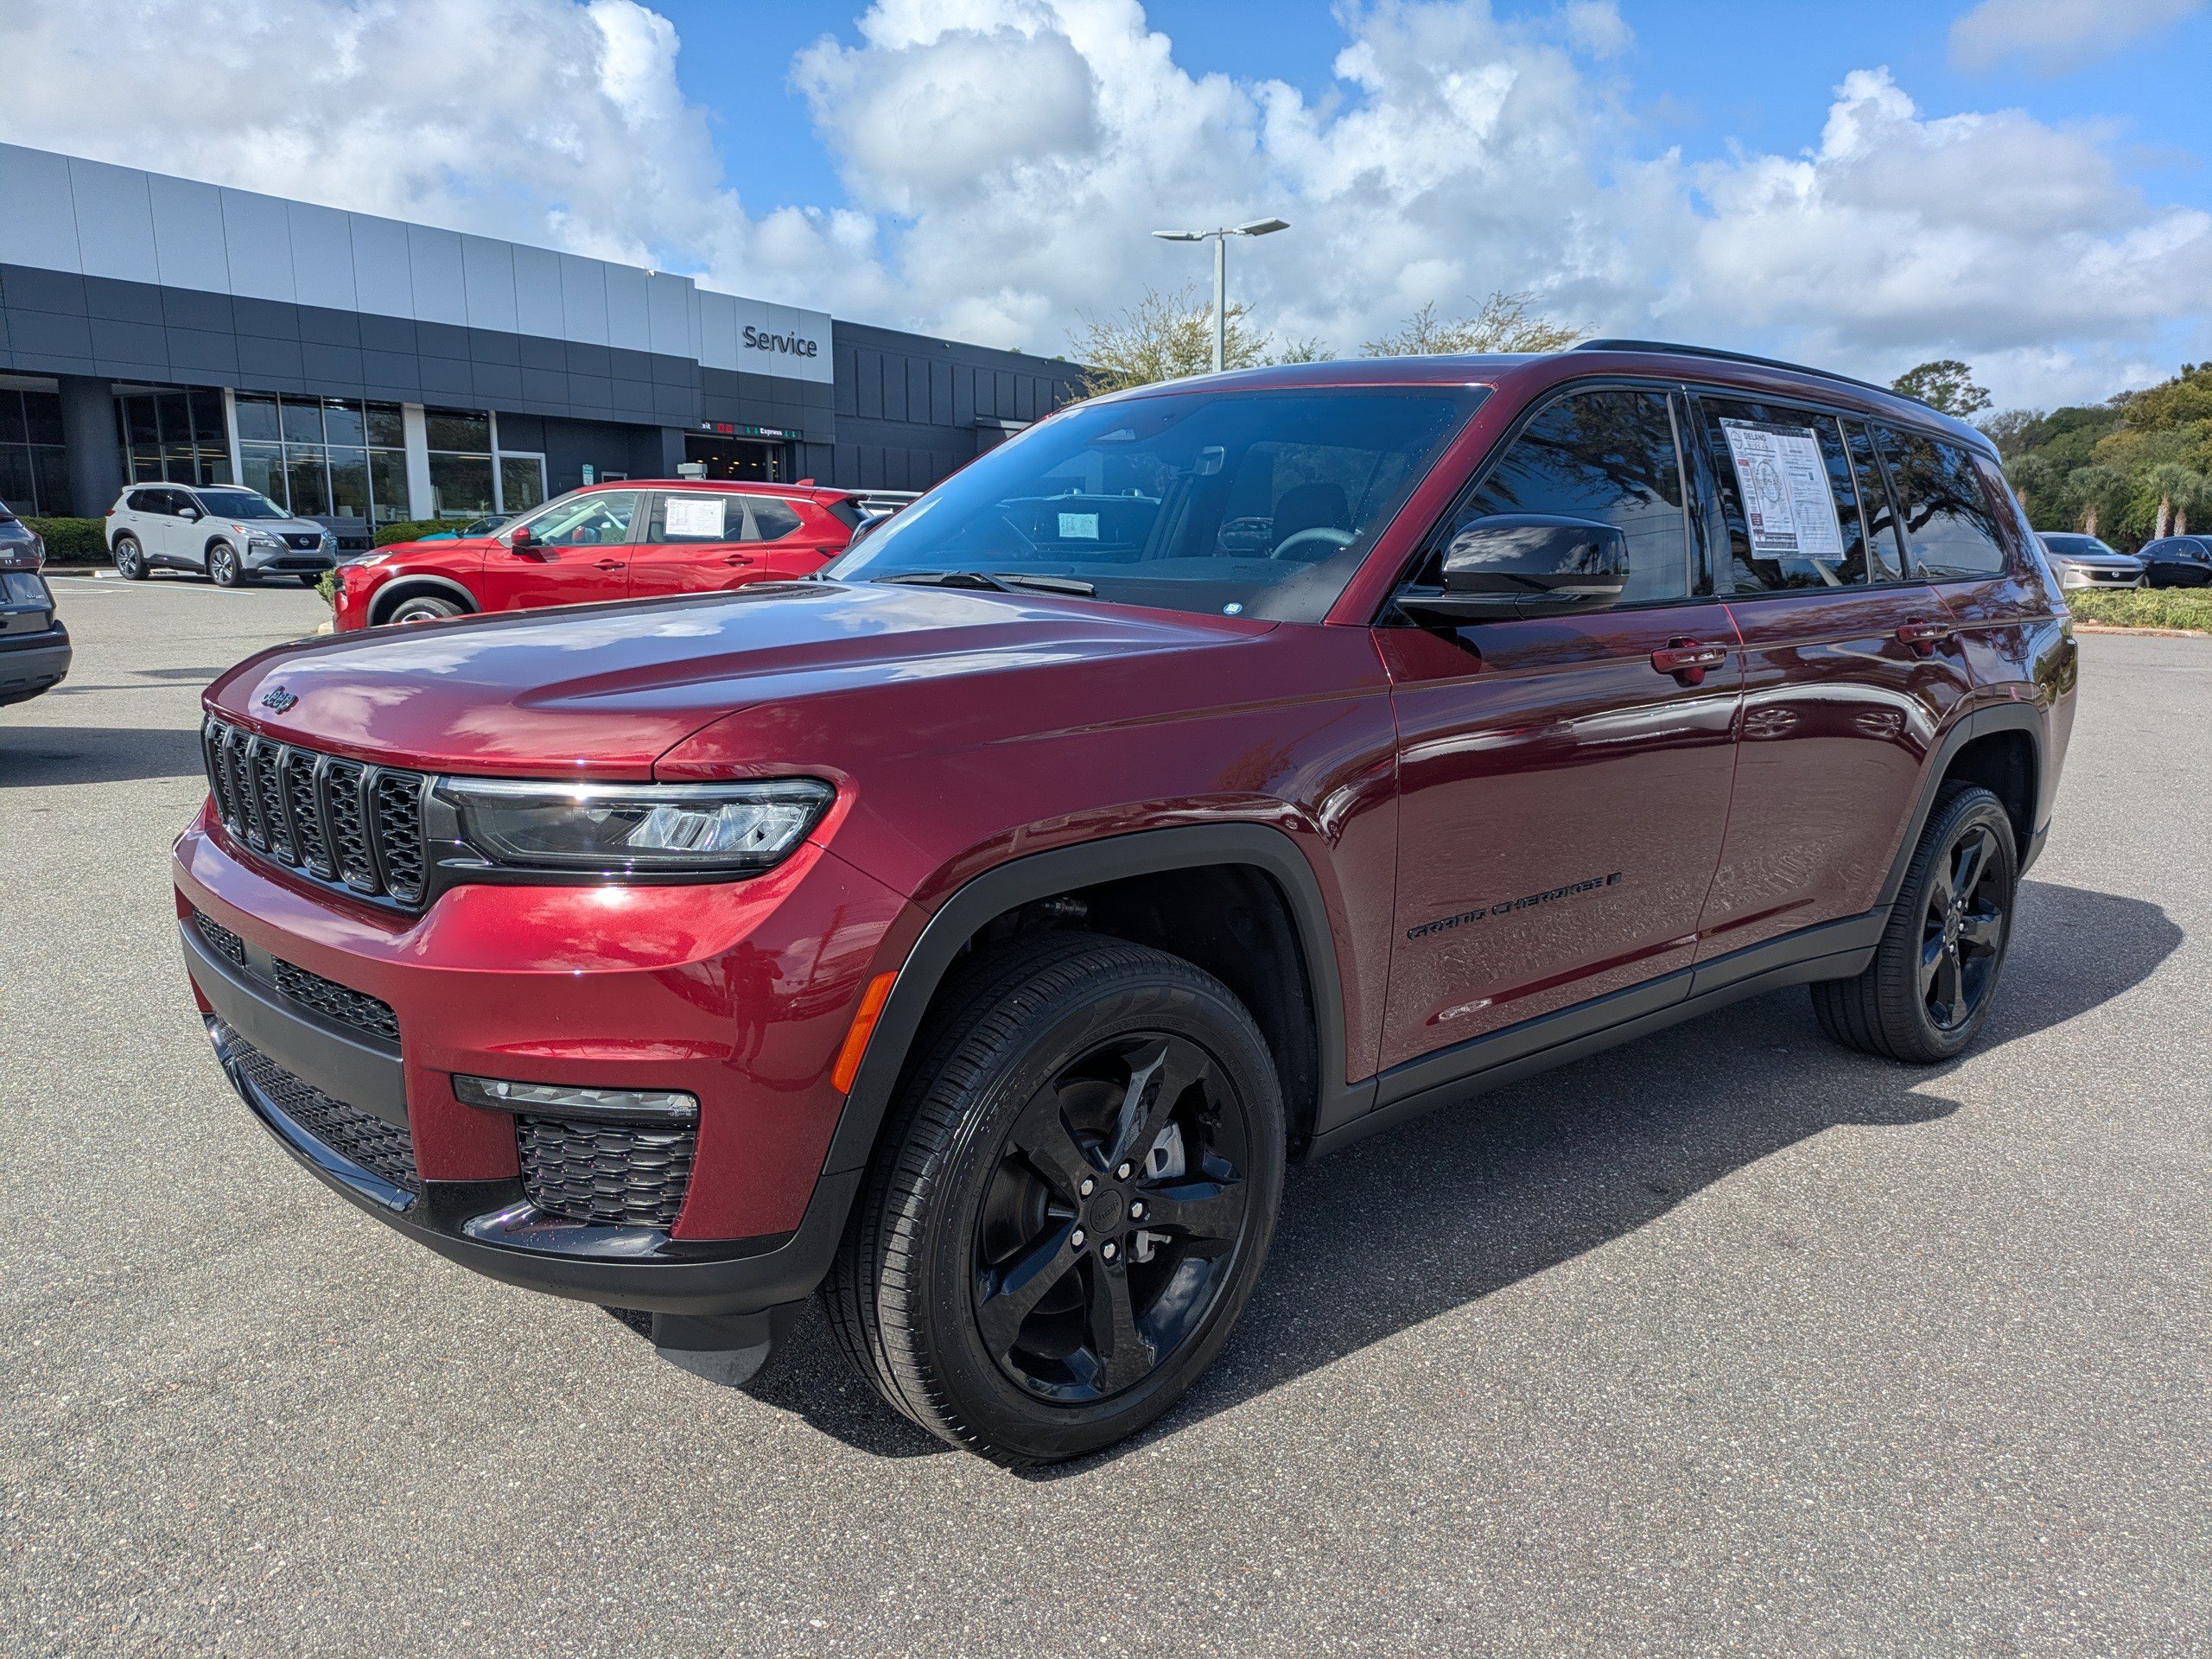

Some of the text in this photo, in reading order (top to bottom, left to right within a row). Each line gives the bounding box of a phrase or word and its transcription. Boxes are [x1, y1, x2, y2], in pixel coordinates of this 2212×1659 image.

[743, 325, 817, 358] Service
[760, 427, 783, 436] Express
[261, 685, 299, 715] Jeep
[1407, 876, 1604, 940] GRAND CHEROKEE
